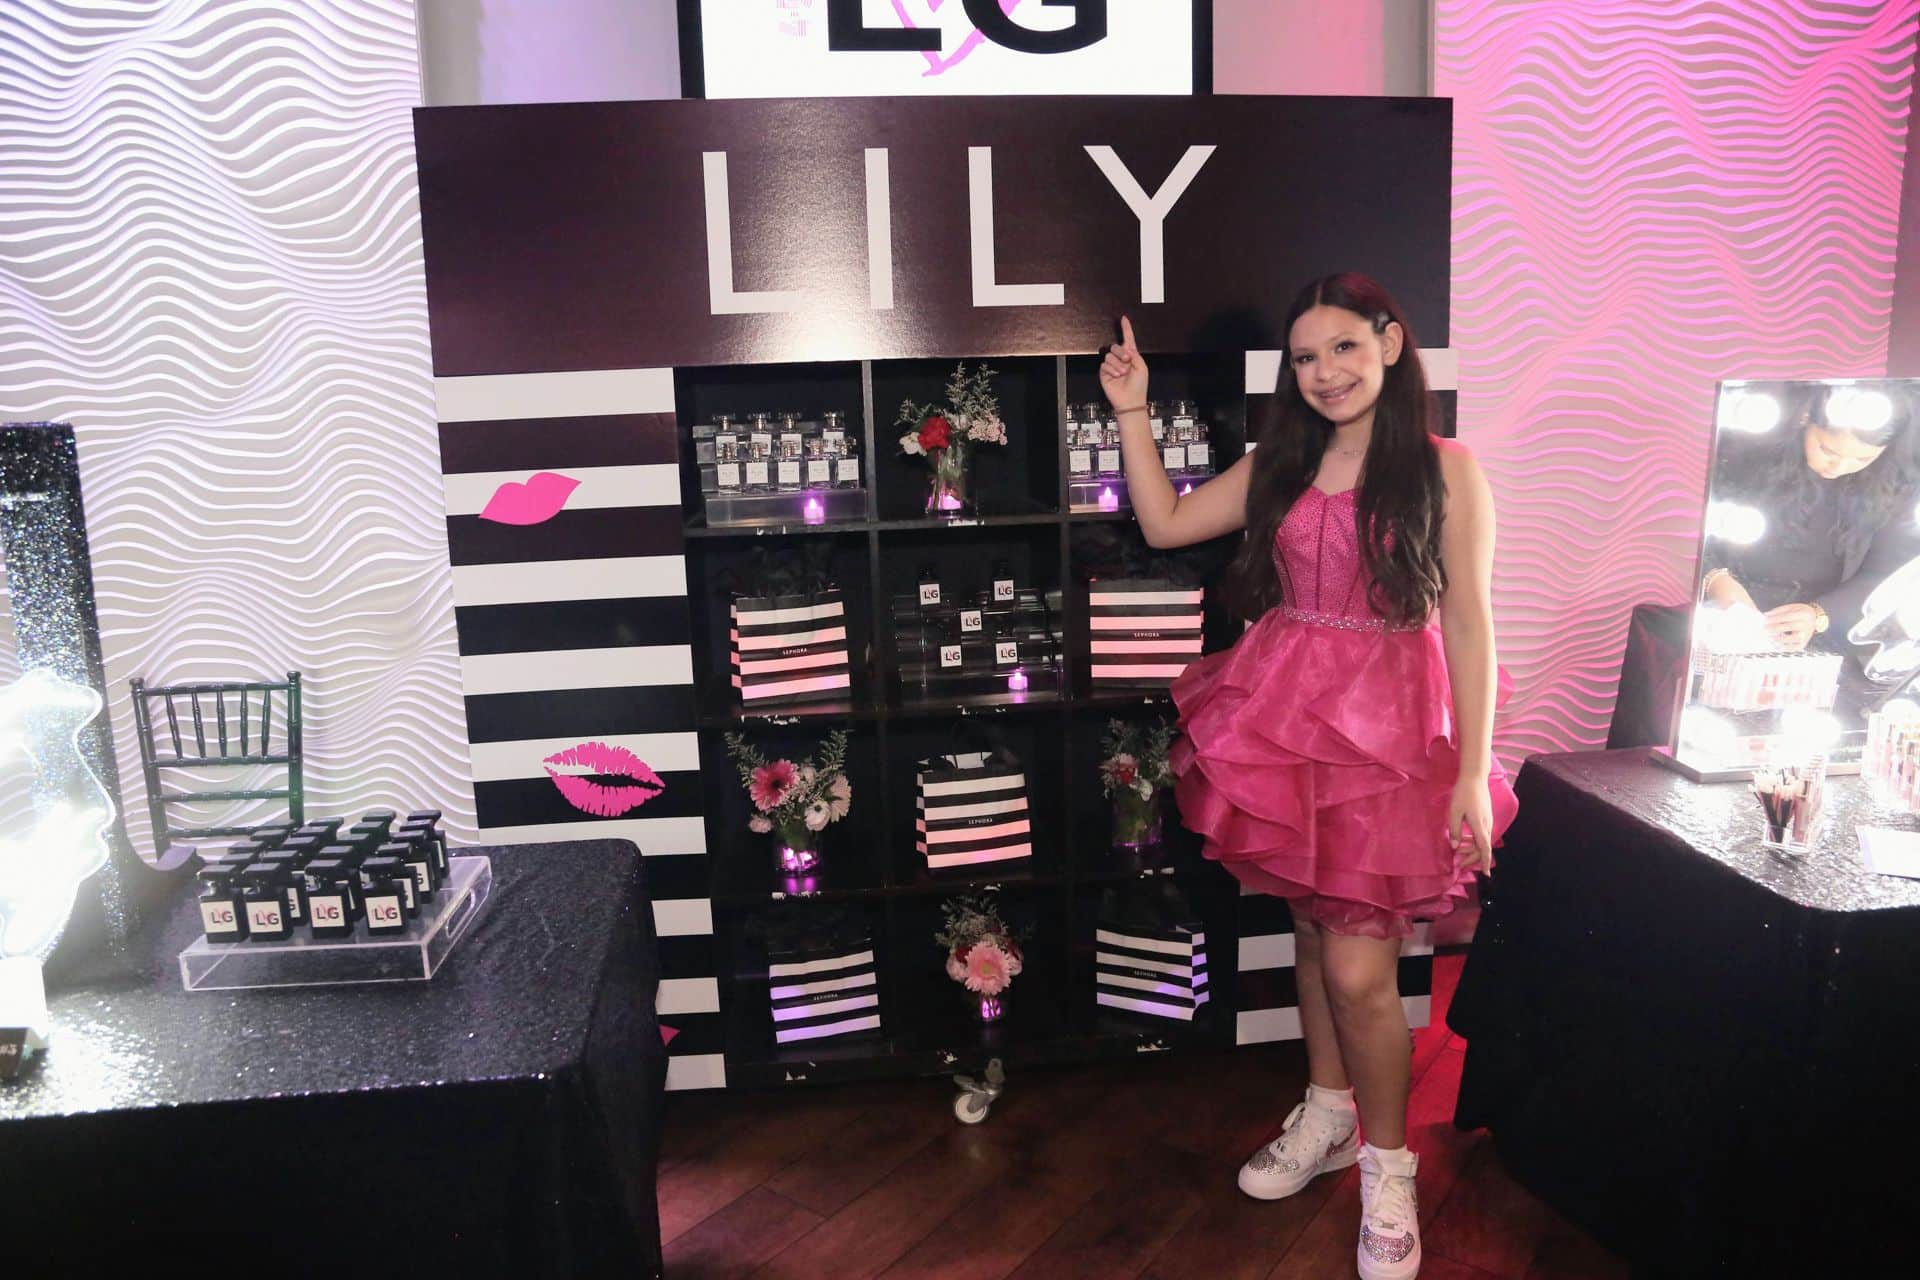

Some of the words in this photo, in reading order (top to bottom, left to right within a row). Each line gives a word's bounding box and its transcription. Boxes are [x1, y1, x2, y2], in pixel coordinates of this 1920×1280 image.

[702, 145, 1217, 315] LILY
[924, 590, 939, 600] LG
[998, 586, 1013, 596] LG
[965, 617, 981, 627] LG
[945, 651, 961, 661] LG
[1001, 649, 1016, 658] LG
[211, 911, 233, 924] LG
[255, 912, 280, 926] LG
[316, 907, 339, 920] LG
[374, 907, 398, 921] LG
